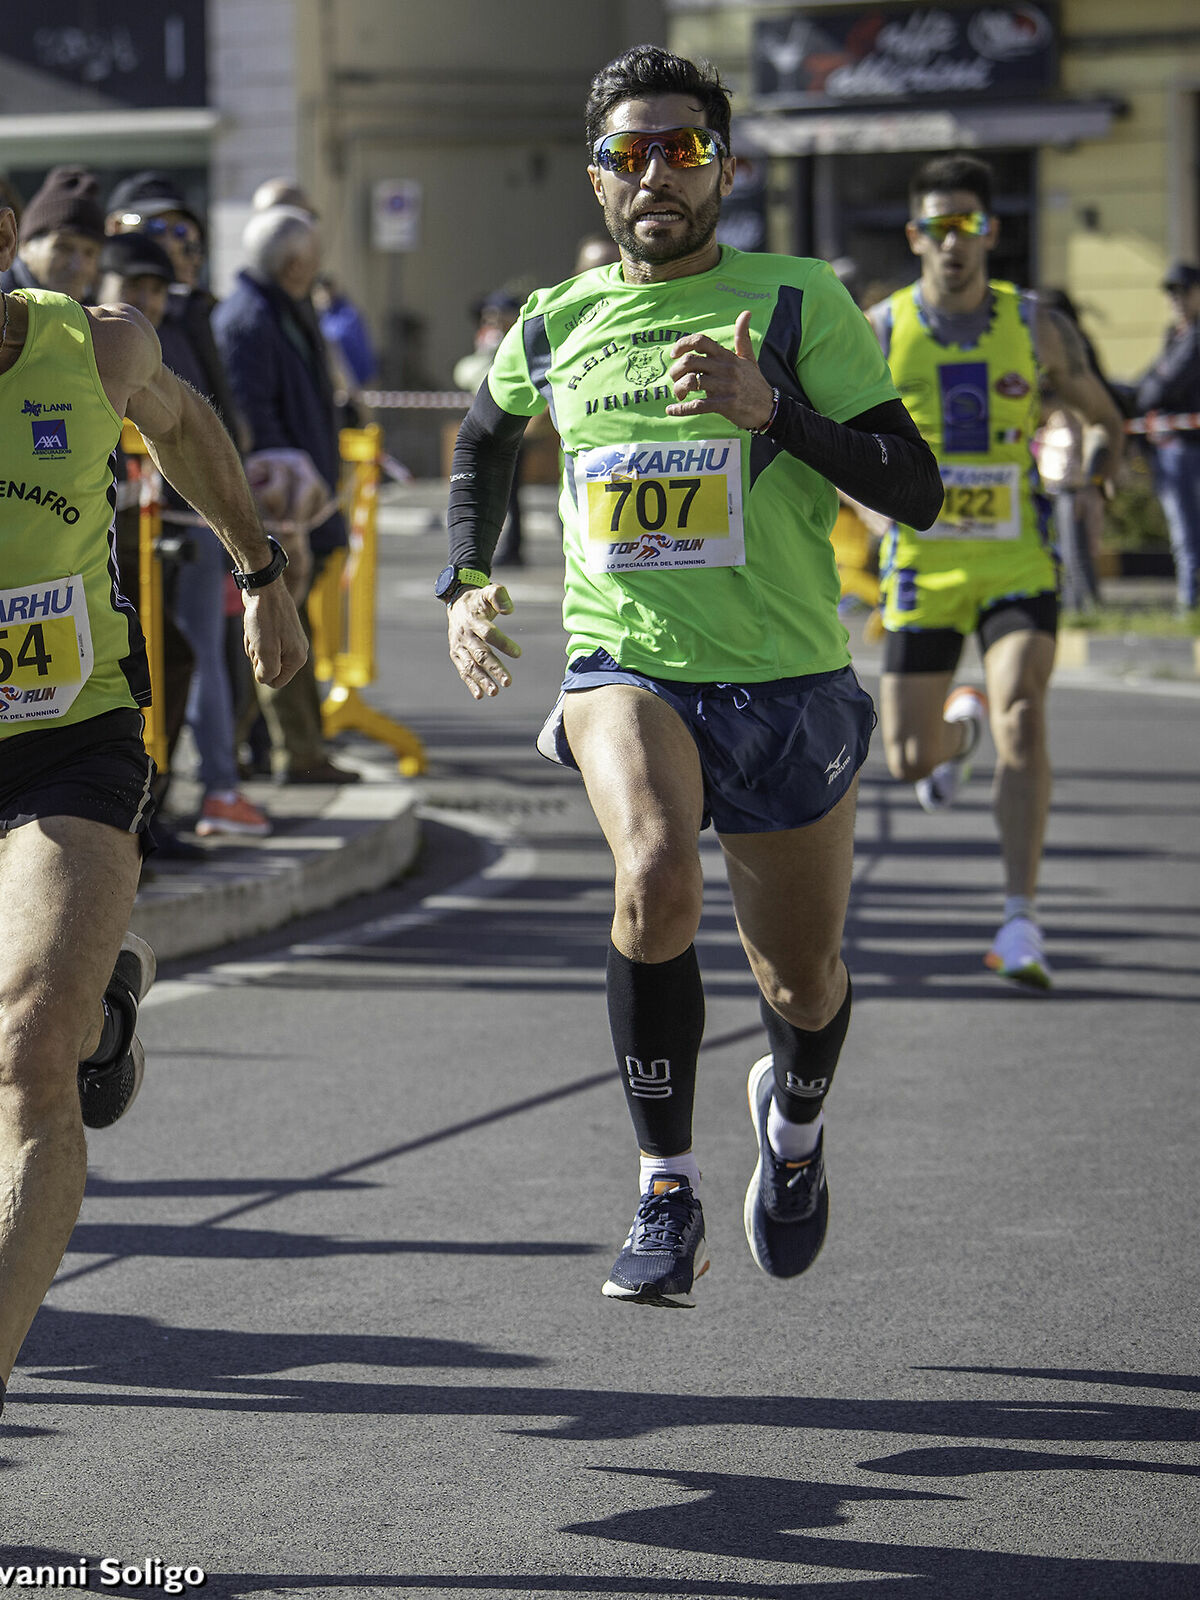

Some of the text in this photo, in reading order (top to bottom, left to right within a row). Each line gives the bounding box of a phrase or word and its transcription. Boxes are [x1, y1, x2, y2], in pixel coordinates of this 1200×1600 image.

[43, 403, 72, 412] LANNI
[34, 435, 62, 448] AXA
[627, 448, 729, 474] KARHU
[605, 479, 701, 531] 707
[608, 539, 705, 555] TOP RUN
[617, 561, 659, 569] SPECIALISTA
[22, 686, 57, 705] RUN
[25, 708, 60, 718] RUNNING
